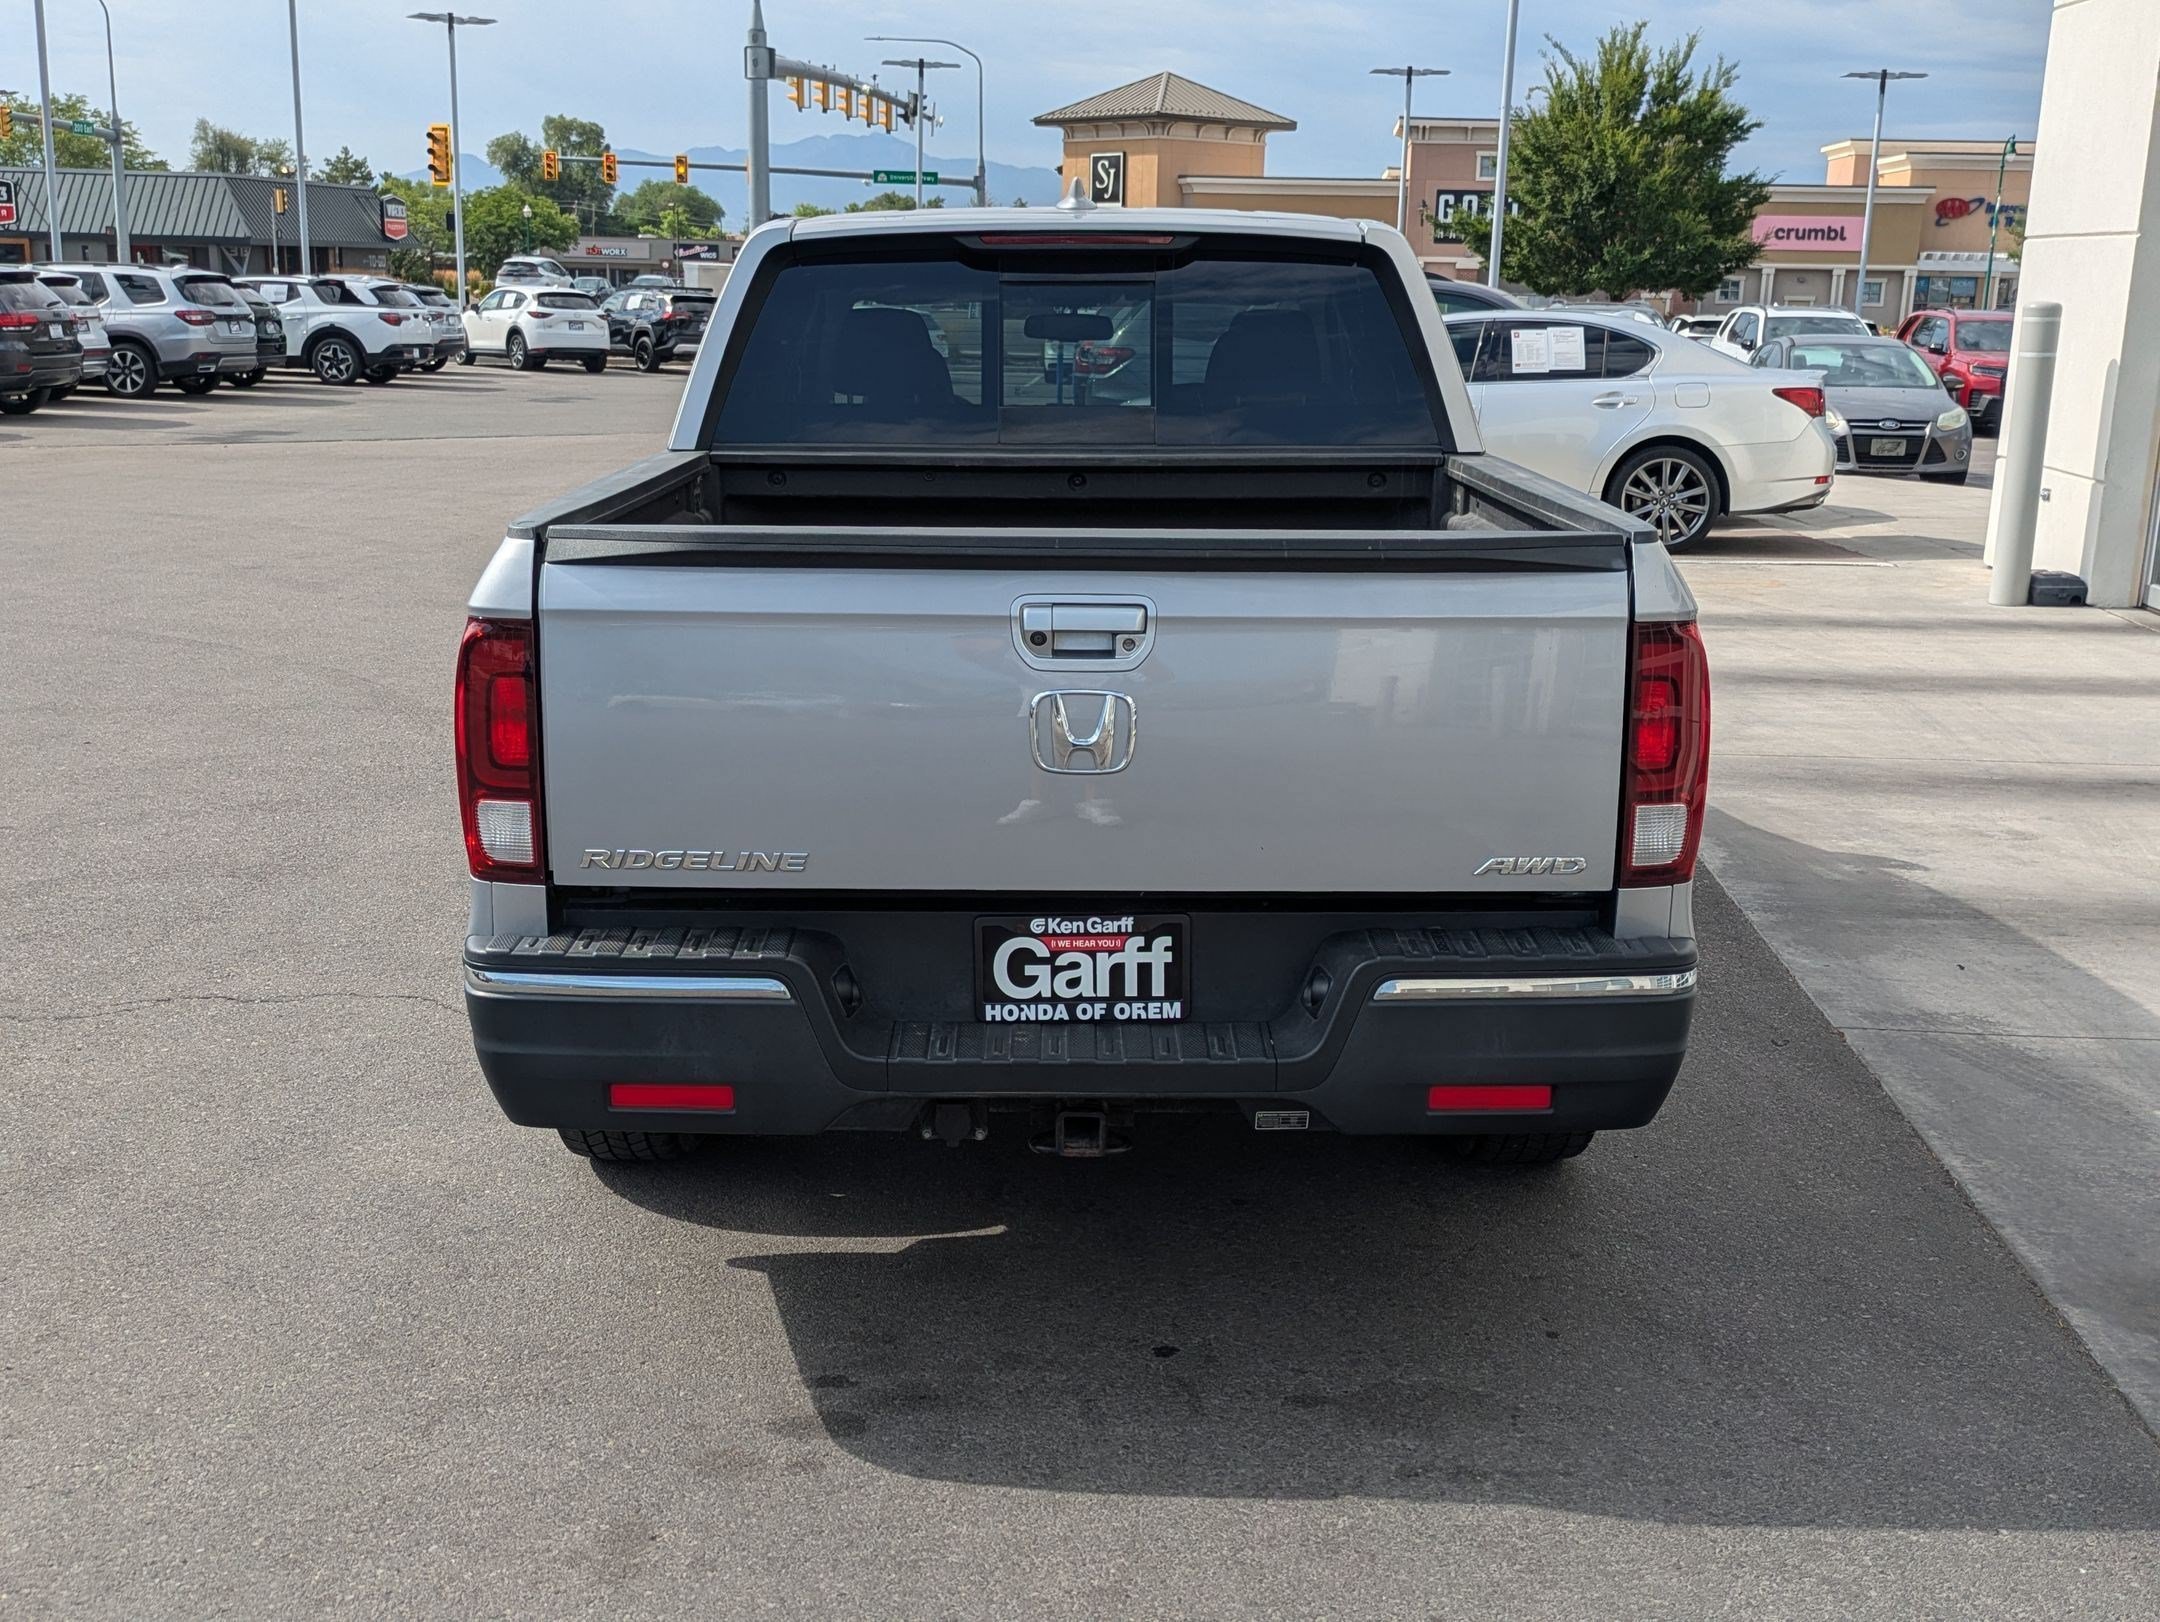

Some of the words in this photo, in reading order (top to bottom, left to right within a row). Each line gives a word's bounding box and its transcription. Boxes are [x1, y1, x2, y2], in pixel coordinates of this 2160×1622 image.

[1774, 225, 1847, 241] crumbl
[580, 849, 809, 872] RIDGELINE
[1473, 857, 1587, 875] AWD
[1048, 918, 1085, 934] Ken
[1086, 916, 1134, 933] Garff
[1058, 940, 1071, 948] WE
[1073, 940, 1095, 948] HEAR
[993, 936, 1173, 999] Garff
[985, 1003, 1070, 1021] HONDA
[1076, 1003, 1107, 1020] OF
[1113, 1001, 1181, 1020] OREM
